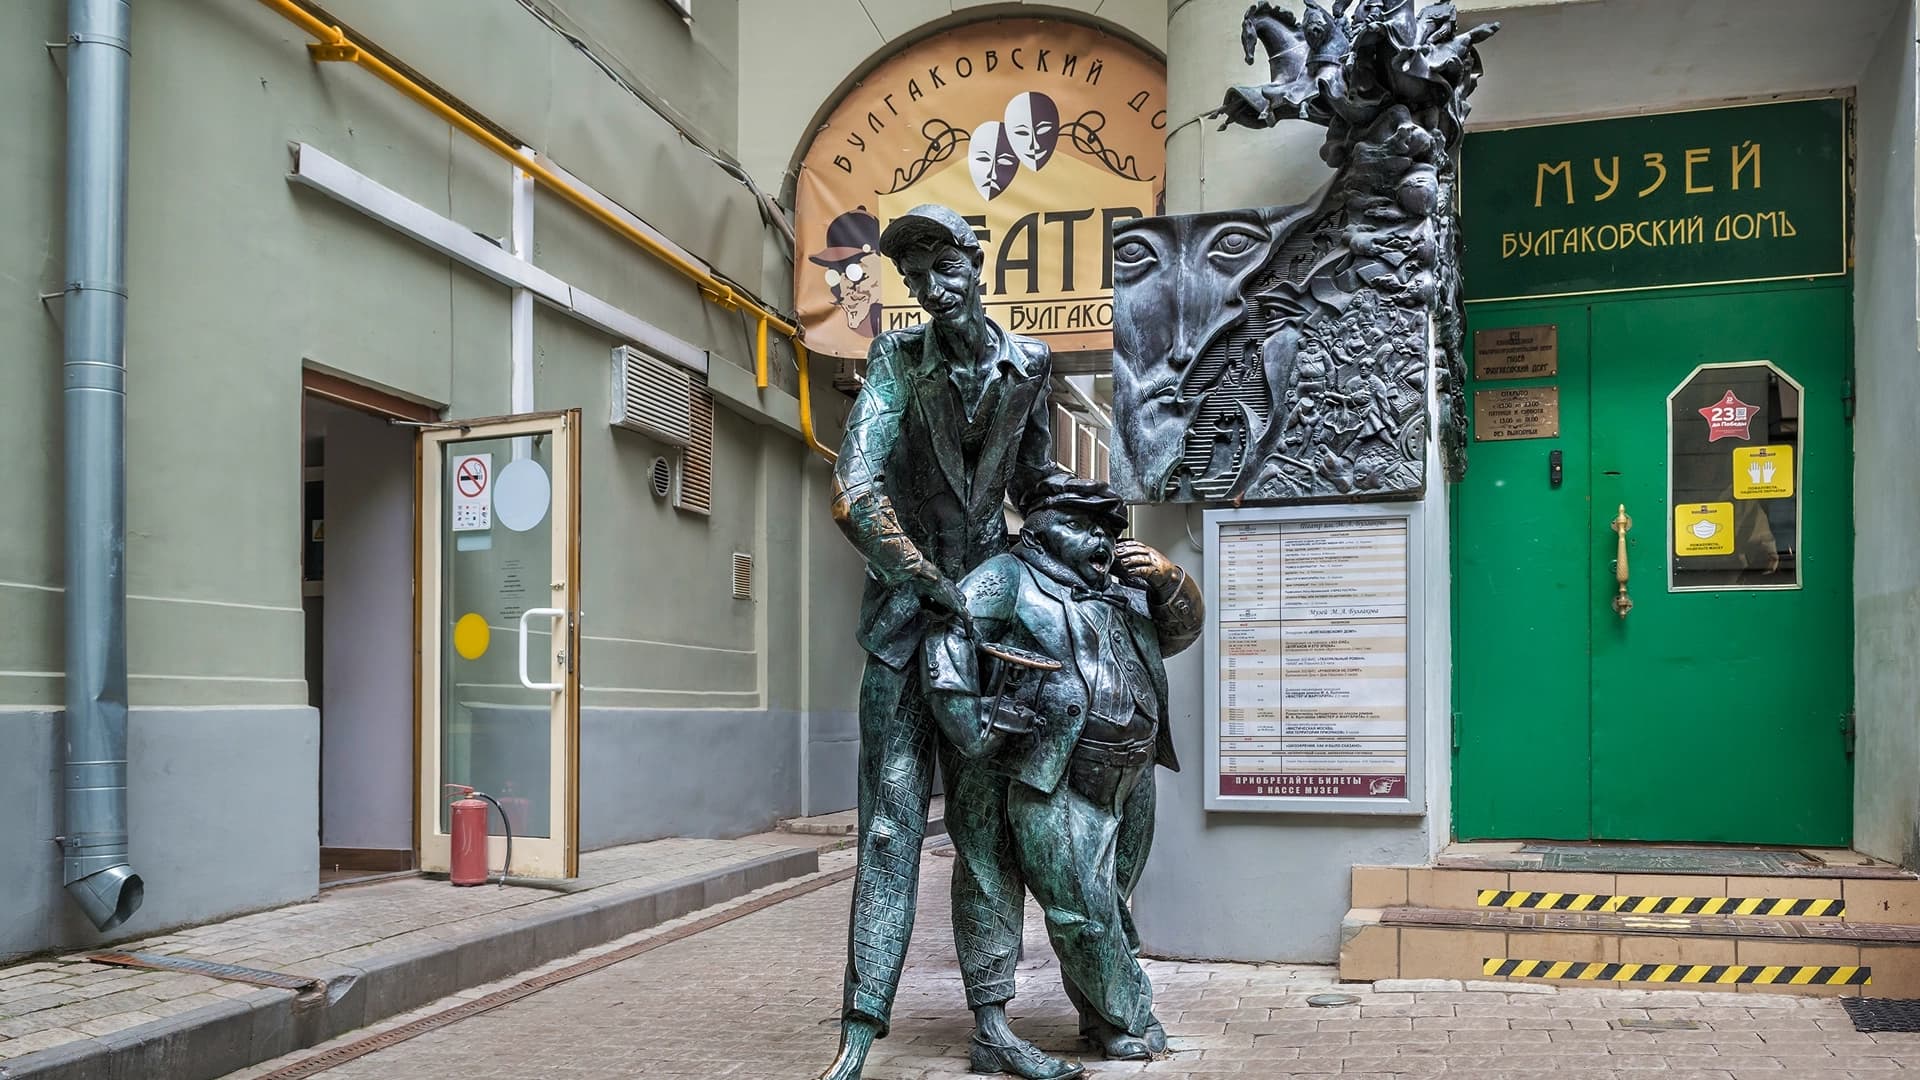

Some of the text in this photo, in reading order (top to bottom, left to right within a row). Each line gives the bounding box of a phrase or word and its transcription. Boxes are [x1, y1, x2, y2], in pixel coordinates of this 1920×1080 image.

[833, 48, 1167, 173] БУЛГАКОВСКИЙ ДО
[1534, 140, 1761, 207] МУЗЕЙ
[1502, 211, 1797, 259] БУЛГАКОВСКИЙ ДОМЪ
[1010, 303, 1113, 331] БУЛГАКО
[1711, 407, 1735, 421] 23
[1235, 775, 1361, 785] ПРИОБРЕТАЙТЕ БИЛЕТЫ
[1257, 786, 1340, 794] В КАССЕ МУЗЕЯ
